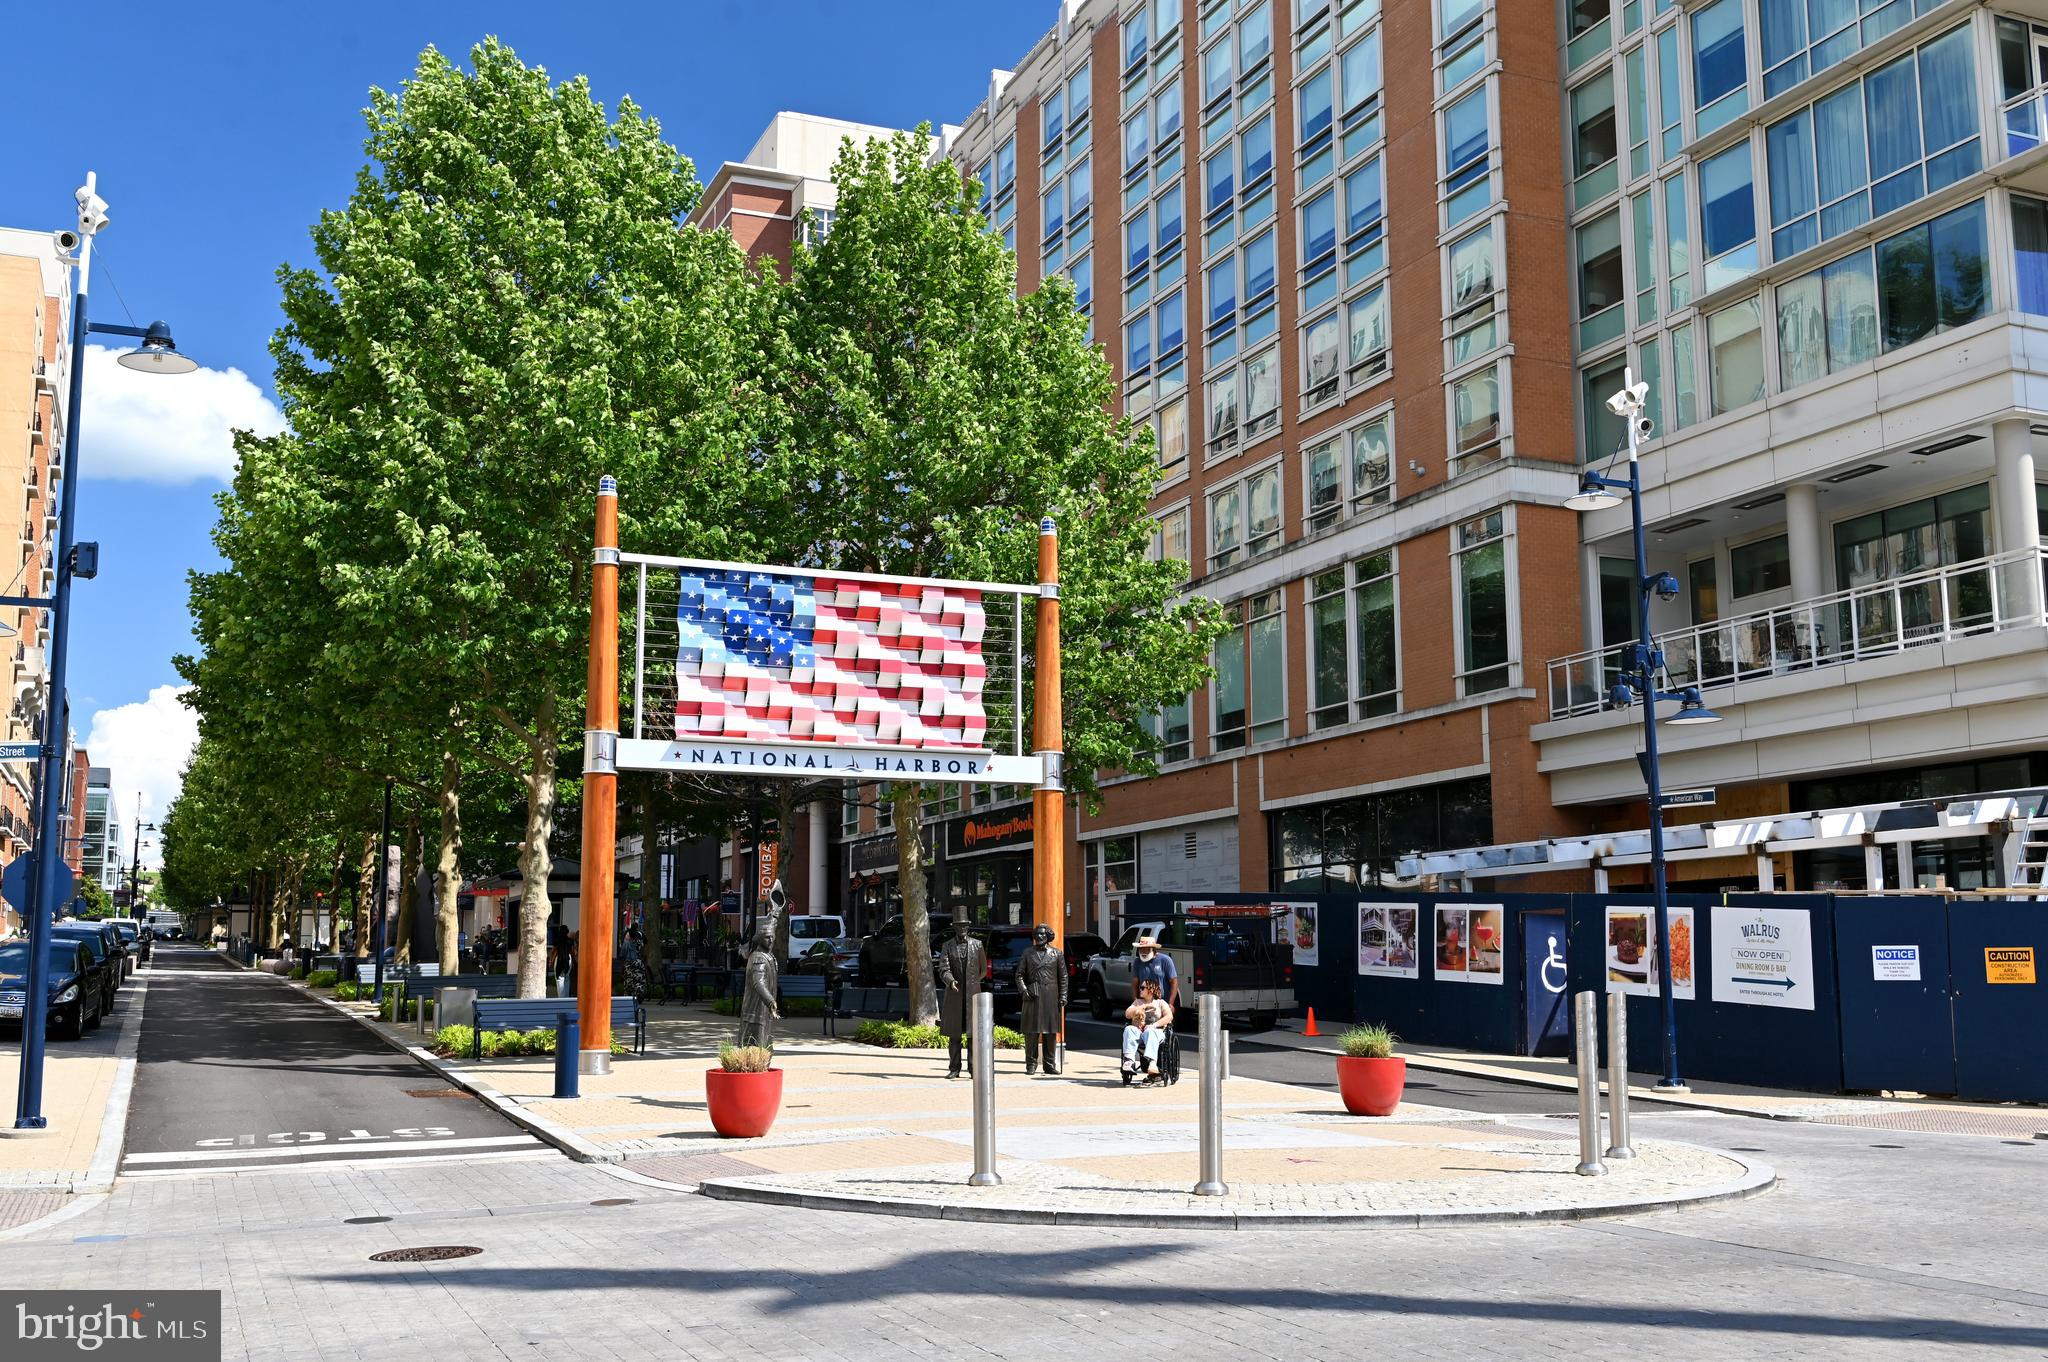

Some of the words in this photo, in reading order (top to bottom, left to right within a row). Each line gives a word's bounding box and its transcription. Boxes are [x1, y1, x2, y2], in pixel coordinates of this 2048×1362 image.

[0, 747, 26, 757] Street
[691, 749, 833, 768] NATIONAL
[875, 756, 979, 775] HARBOR
[976, 817, 1034, 840] MahoganyBook
[761, 842, 772, 896] BOMBA
[1741, 924, 1780, 939] WALRUS
[1737, 950, 1757, 959] NOW
[1759, 951, 1785, 960] OPEN!
[1876, 950, 1915, 959] NOTICE
[1990, 952, 2029, 961] CAUTION
[1736, 962, 1754, 971] DINING
[1755, 963, 1770, 972] ROOM
[1770, 964, 1775, 972] &
[1776, 965, 1787, 973] BAR
[195, 1127, 456, 1147] STOP
